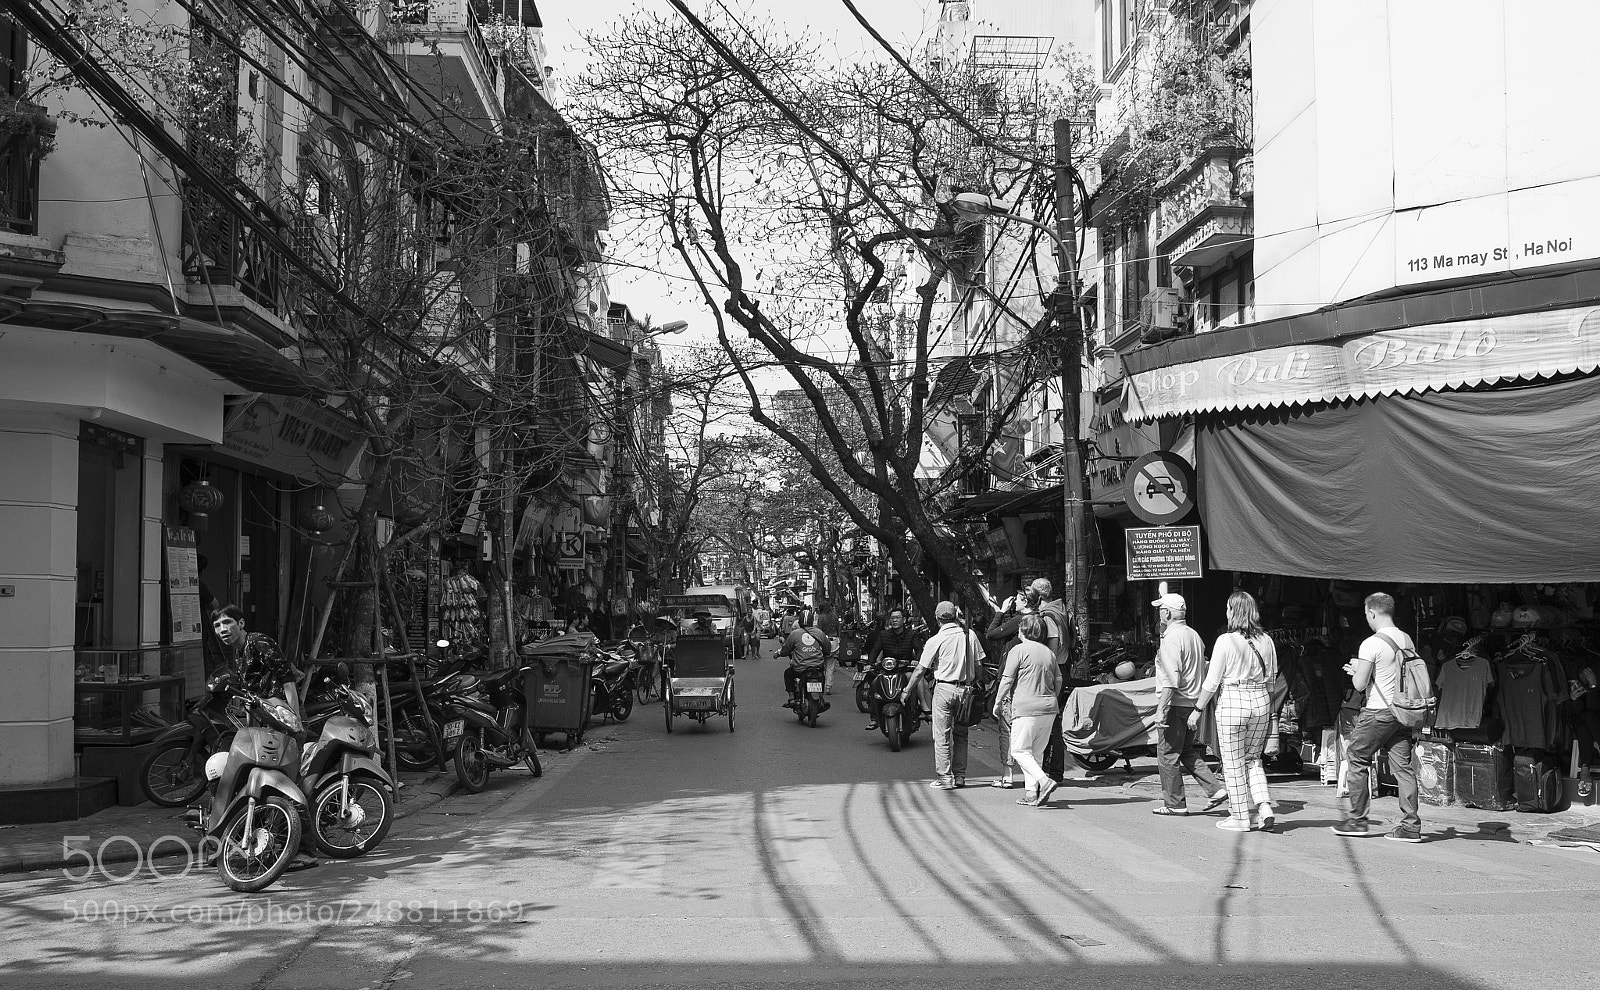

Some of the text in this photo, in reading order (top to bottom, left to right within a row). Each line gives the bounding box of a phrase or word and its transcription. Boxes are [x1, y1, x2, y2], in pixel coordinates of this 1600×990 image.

[1408, 257, 1428, 272] 113
[1433, 254, 1454, 269] Ma
[1457, 252, 1488, 267] may
[1493, 247, 1508, 261] St
[1524, 242, 1544, 257] Ha
[1547, 237, 1572, 253] Noi
[1135, 368, 1200, 401] Shop
[1354, 328, 1504, 371] Balô
[1100, 464, 1121, 487] TRAVEL
[1135, 530, 1156, 538] TUYẾN
[1158, 530, 1172, 538] PHỐ
[1182, 530, 1192, 538] BỘ
